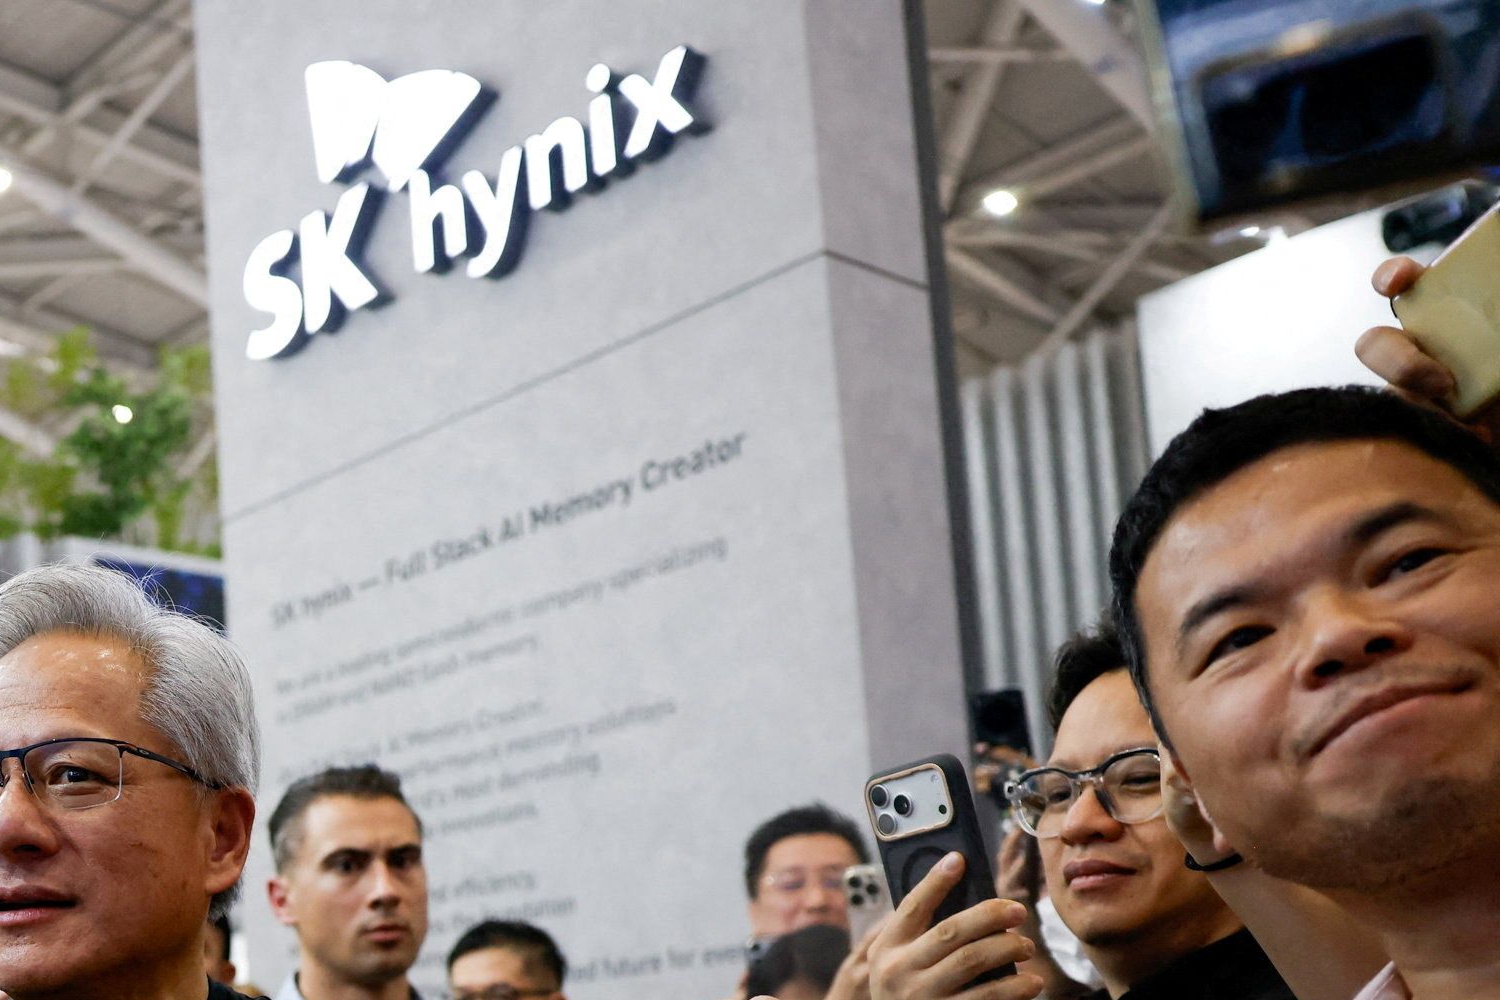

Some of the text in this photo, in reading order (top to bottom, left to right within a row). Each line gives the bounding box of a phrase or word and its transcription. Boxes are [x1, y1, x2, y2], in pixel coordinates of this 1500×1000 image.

[243, 45, 695, 361] SK hynix
[385, 550, 427, 585] Full
[430, 525, 494, 571] Stack
[500, 514, 523, 544] AI
[529, 474, 635, 534] Memory
[640, 432, 747, 492] Creator
[520, 579, 603, 617] company
[601, 954, 662, 982] future
